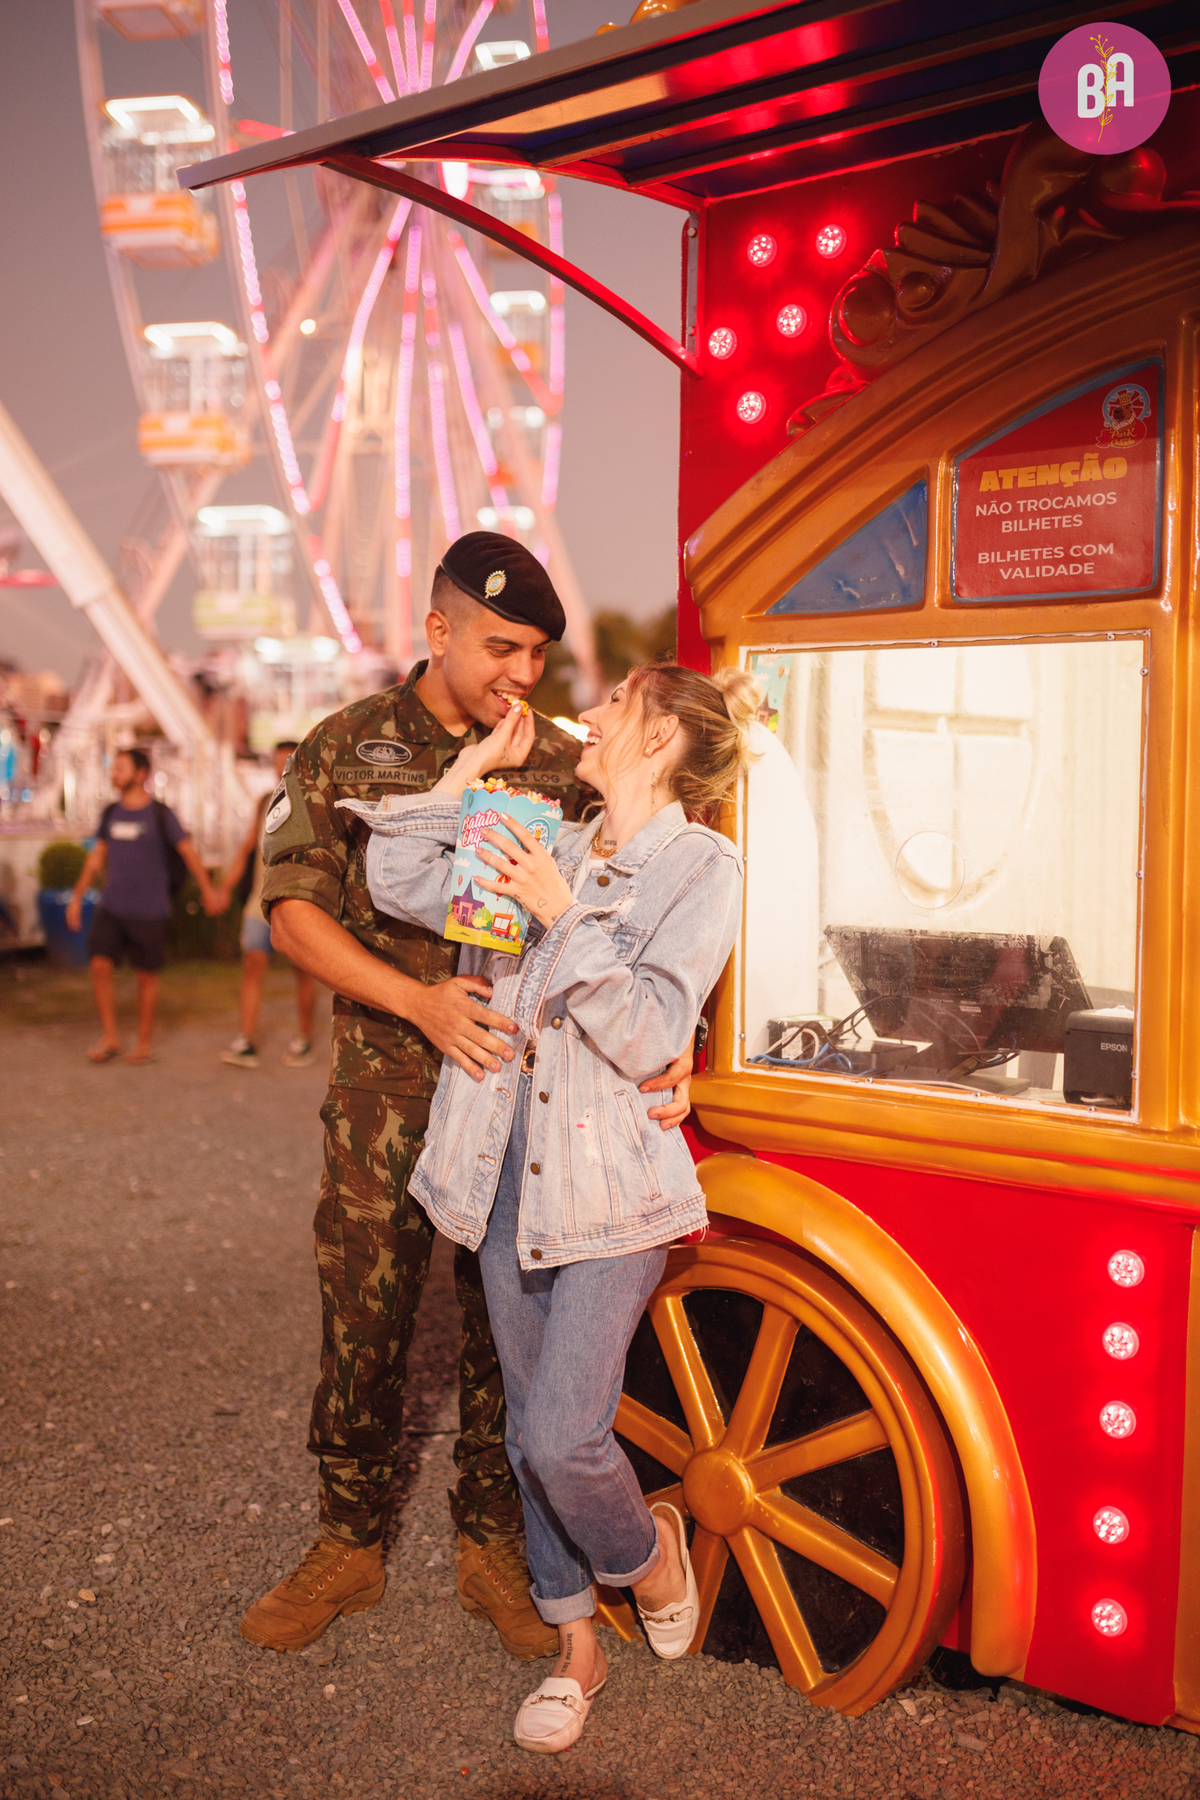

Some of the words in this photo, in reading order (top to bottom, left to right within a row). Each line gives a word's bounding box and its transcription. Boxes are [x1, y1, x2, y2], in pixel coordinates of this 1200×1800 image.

[979, 452, 1128, 492] ATENÇÃO
[975, 500, 1013, 517] NÃO
[1017, 492, 1117, 512] TROCAMOS
[1001, 514, 1083, 533] BILHETES
[977, 546, 1065, 564] BILHETES
[1069, 542, 1114, 557] COM
[999, 562, 1095, 580] VALIDADE
[335, 770, 374, 781] VICTOR
[377, 770, 425, 783] MARTINS
[519, 774, 528, 782] B
[533, 772, 560, 783] LOG
[462, 808, 500, 833] Batata
[462, 828, 489, 848] Chip
[1100, 1042, 1128, 1052] EPSON
